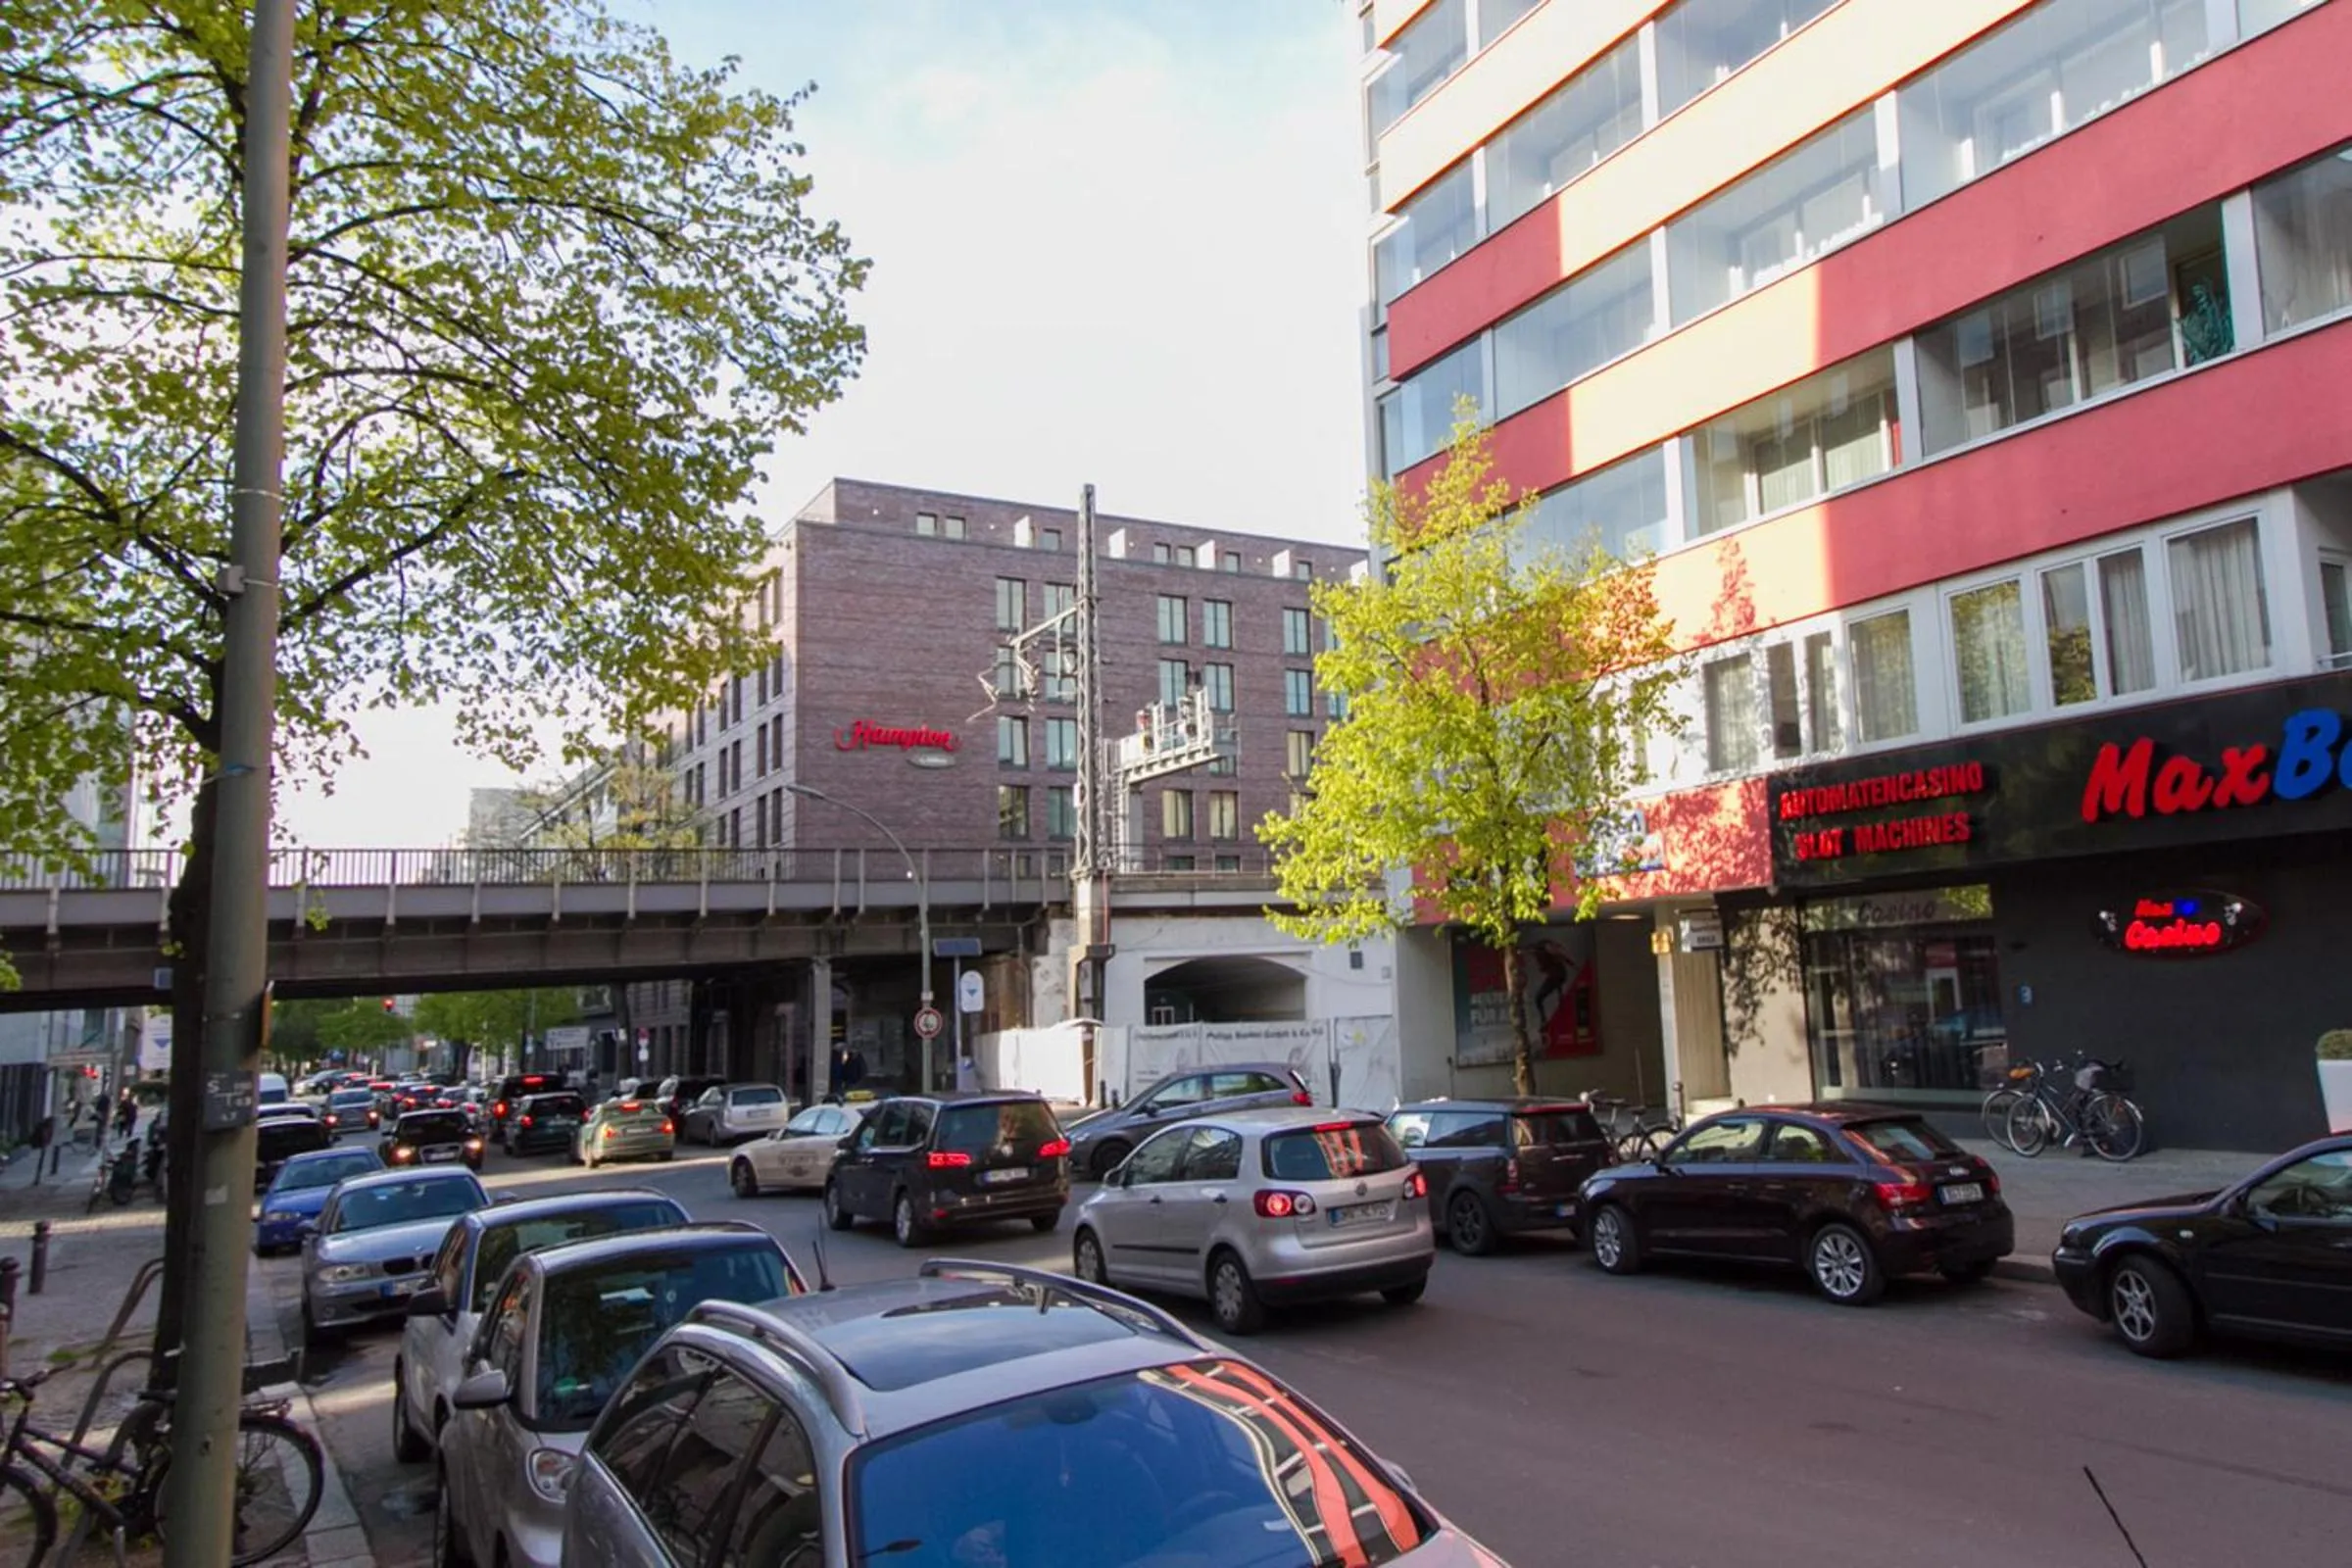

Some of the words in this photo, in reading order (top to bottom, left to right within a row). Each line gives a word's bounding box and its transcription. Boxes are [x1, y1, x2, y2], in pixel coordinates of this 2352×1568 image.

[833, 717, 960, 752] Hampton
[1779, 760, 1983, 820] AUTOMATENCASINO
[1793, 828, 1843, 861] SLOT
[1853, 811, 1971, 853] MACHINES
[2125, 918, 2222, 950] Casino
